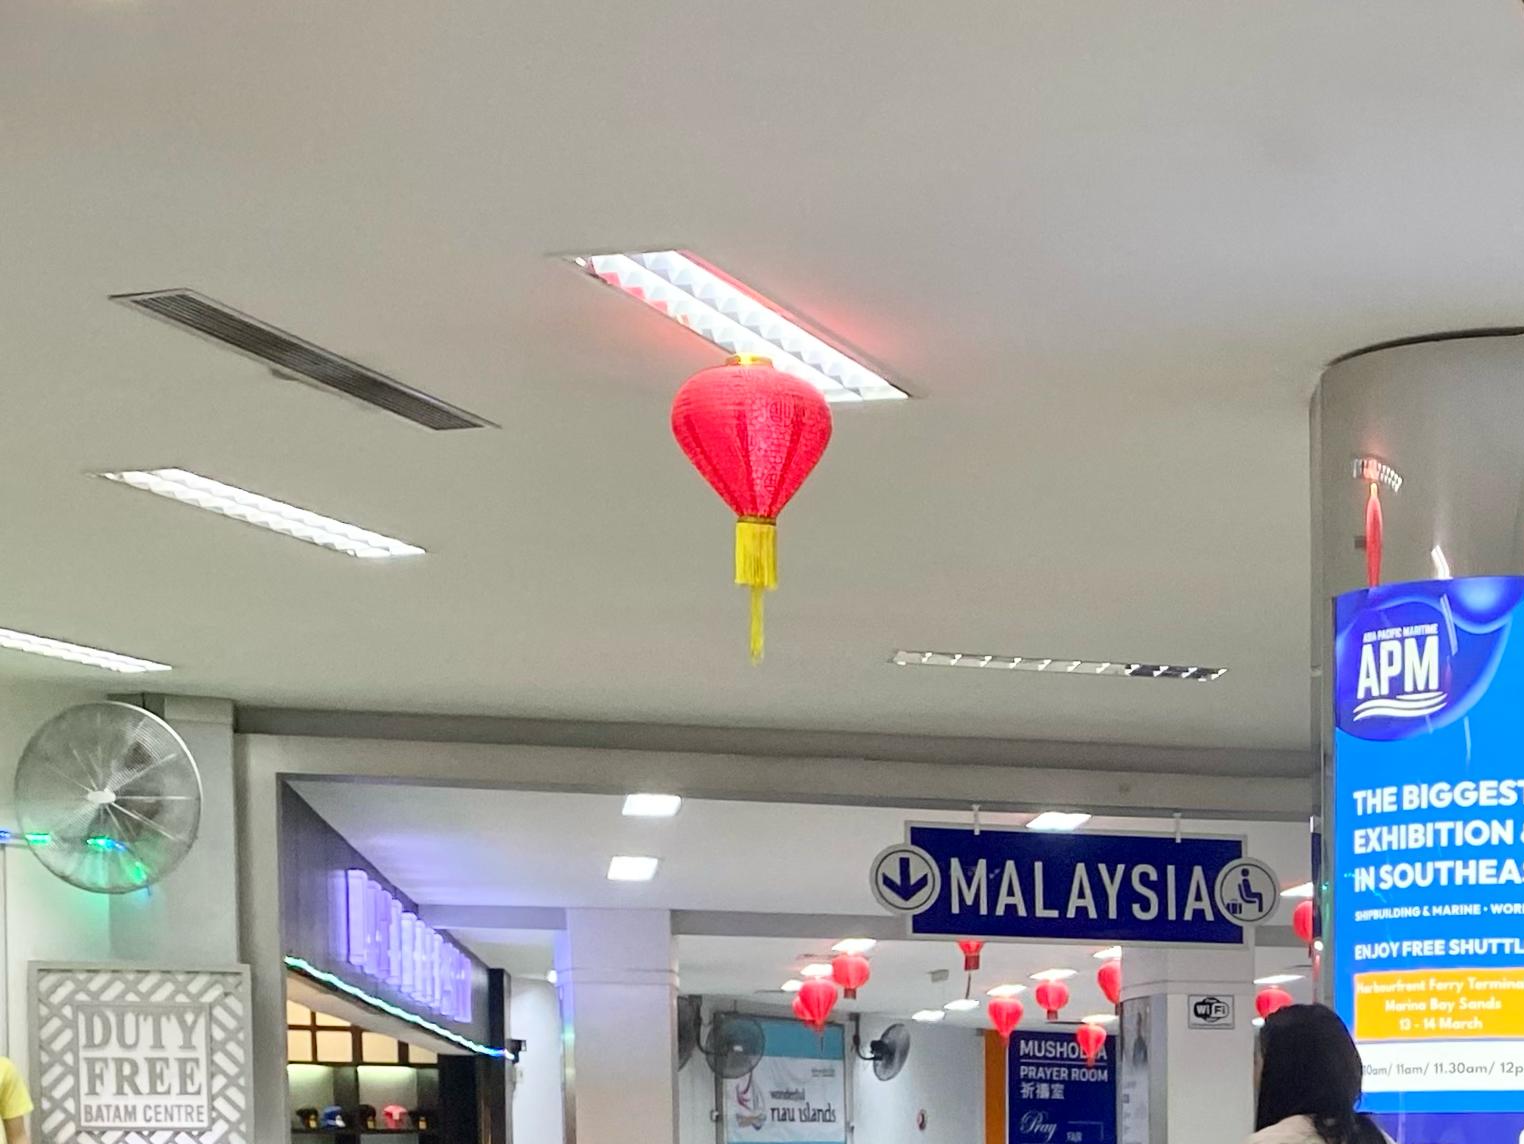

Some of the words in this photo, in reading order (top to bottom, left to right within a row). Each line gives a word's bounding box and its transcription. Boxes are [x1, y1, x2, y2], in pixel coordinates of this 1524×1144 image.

[1357, 635, 1439, 699] APM
[1353, 786, 1398, 816] THE
[1354, 819, 1514, 854] EXHIBITION
[949, 857, 1215, 922] MALAYSIA
[1354, 866, 1375, 893] IN
[1354, 906, 1421, 922] SHIPBUILDING
[1422, 905, 1432, 917] &
[1432, 904, 1482, 917] MARINE
[1354, 942, 1400, 961] ENJOY
[1402, 939, 1445, 957] FREE
[1429, 977, 1464, 993] Ferry
[1385, 998, 1427, 1012] Marina
[1430, 997, 1455, 1013] Bay
[1459, 996, 1502, 1010] Sands
[81, 1004, 204, 1050] DUTY
[1439, 1016, 1483, 1030] March
[1019, 1039, 1108, 1060] MUSHOLA
[83, 1056, 203, 1096] FREE
[1019, 1065, 1070, 1082] PRAYER
[1071, 1068, 1109, 1083] ROOM
[1434, 1061, 1496, 1076] 11.30am/
[84, 1104, 137, 1123] BATAM
[143, 1104, 206, 1123] CENTRE
[1020, 1110, 1059, 1144] Pray
